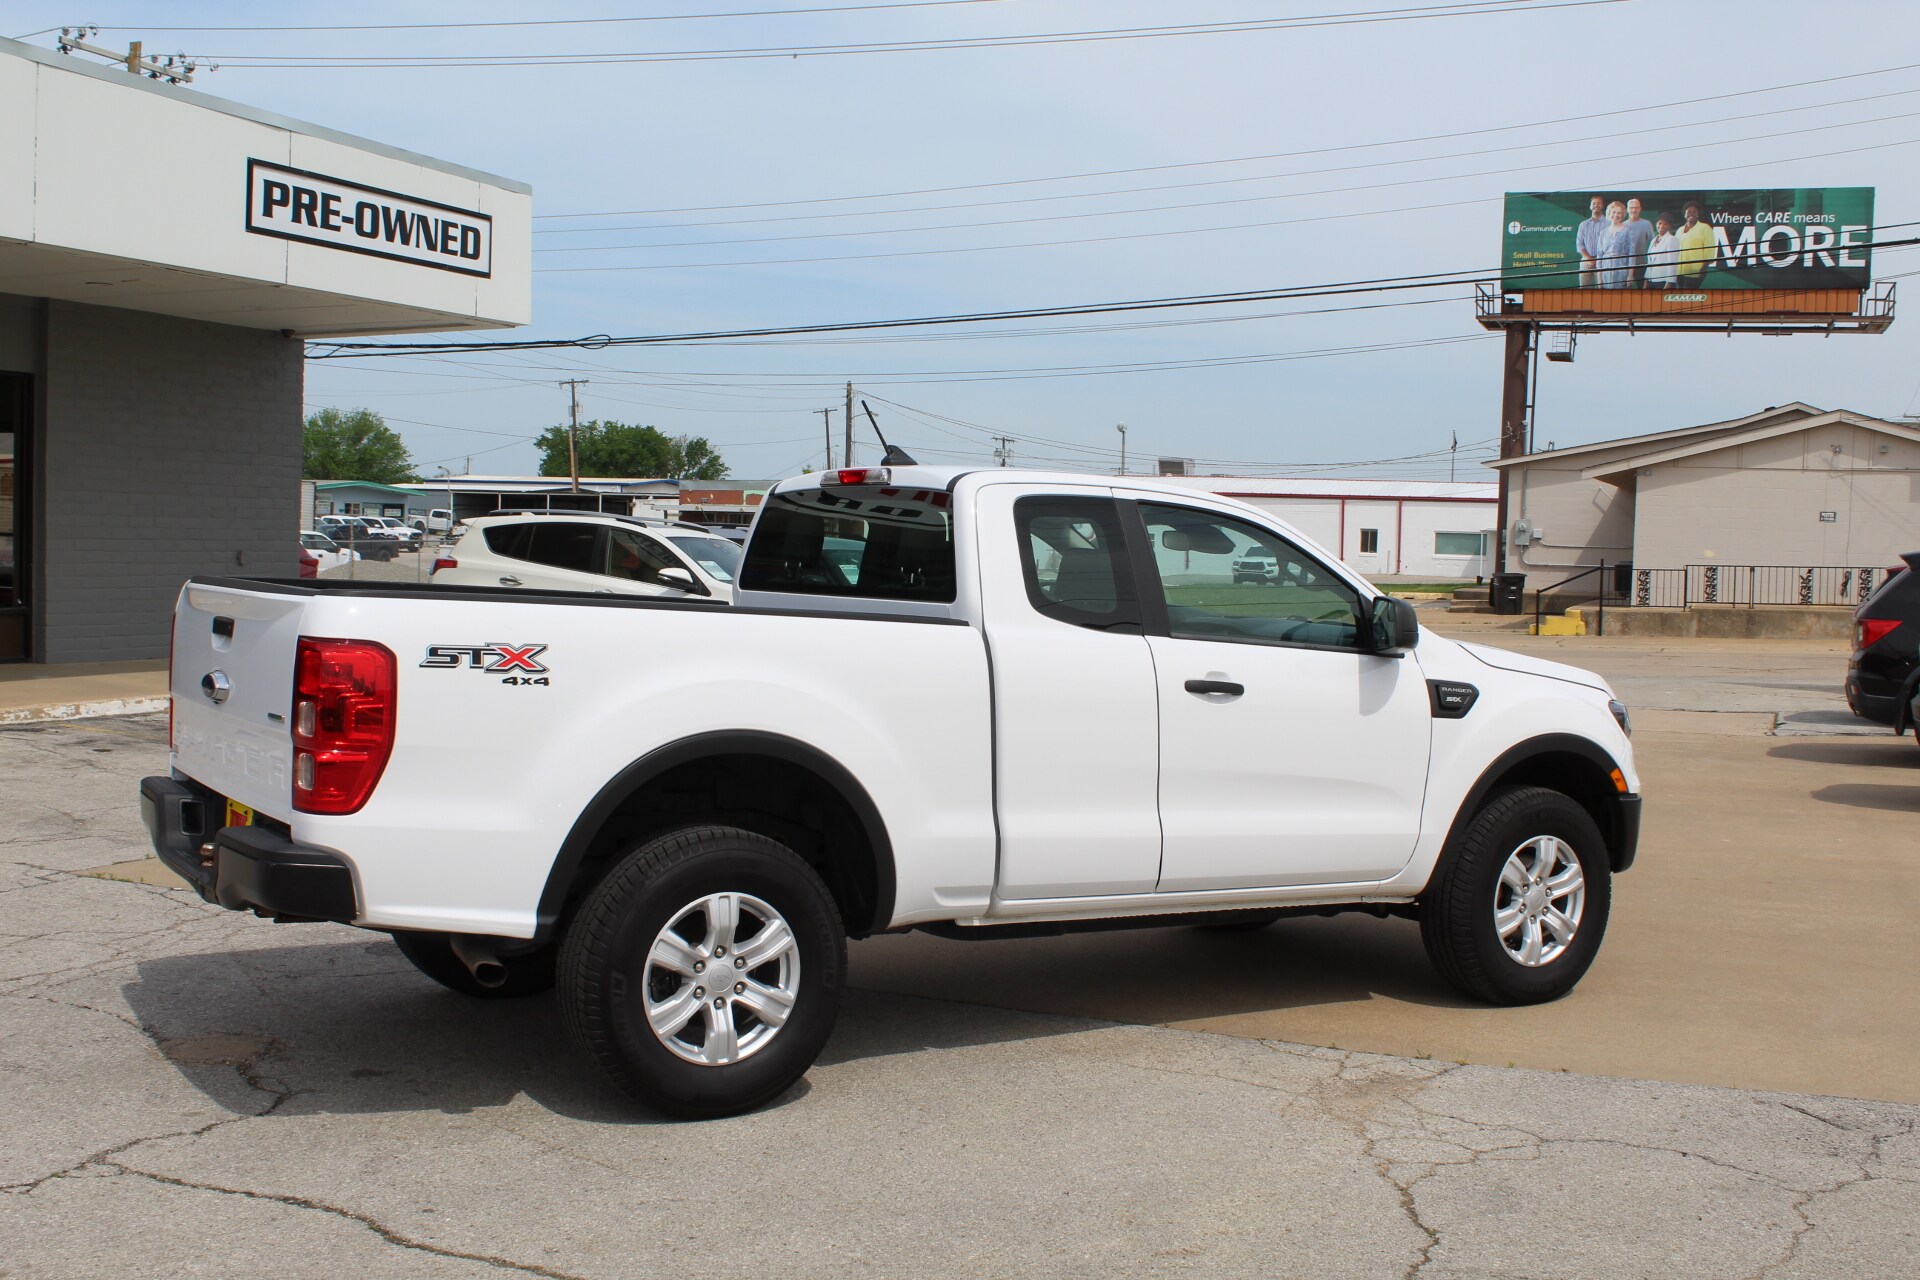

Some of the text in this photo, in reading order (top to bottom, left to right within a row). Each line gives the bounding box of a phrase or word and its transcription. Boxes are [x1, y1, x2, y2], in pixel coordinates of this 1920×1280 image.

[262, 178, 481, 261] PRE-OWNED
[1710, 212, 1836, 224] Where CARE means
[1708, 225, 1868, 268] MORE
[419, 642, 550, 674] STX
